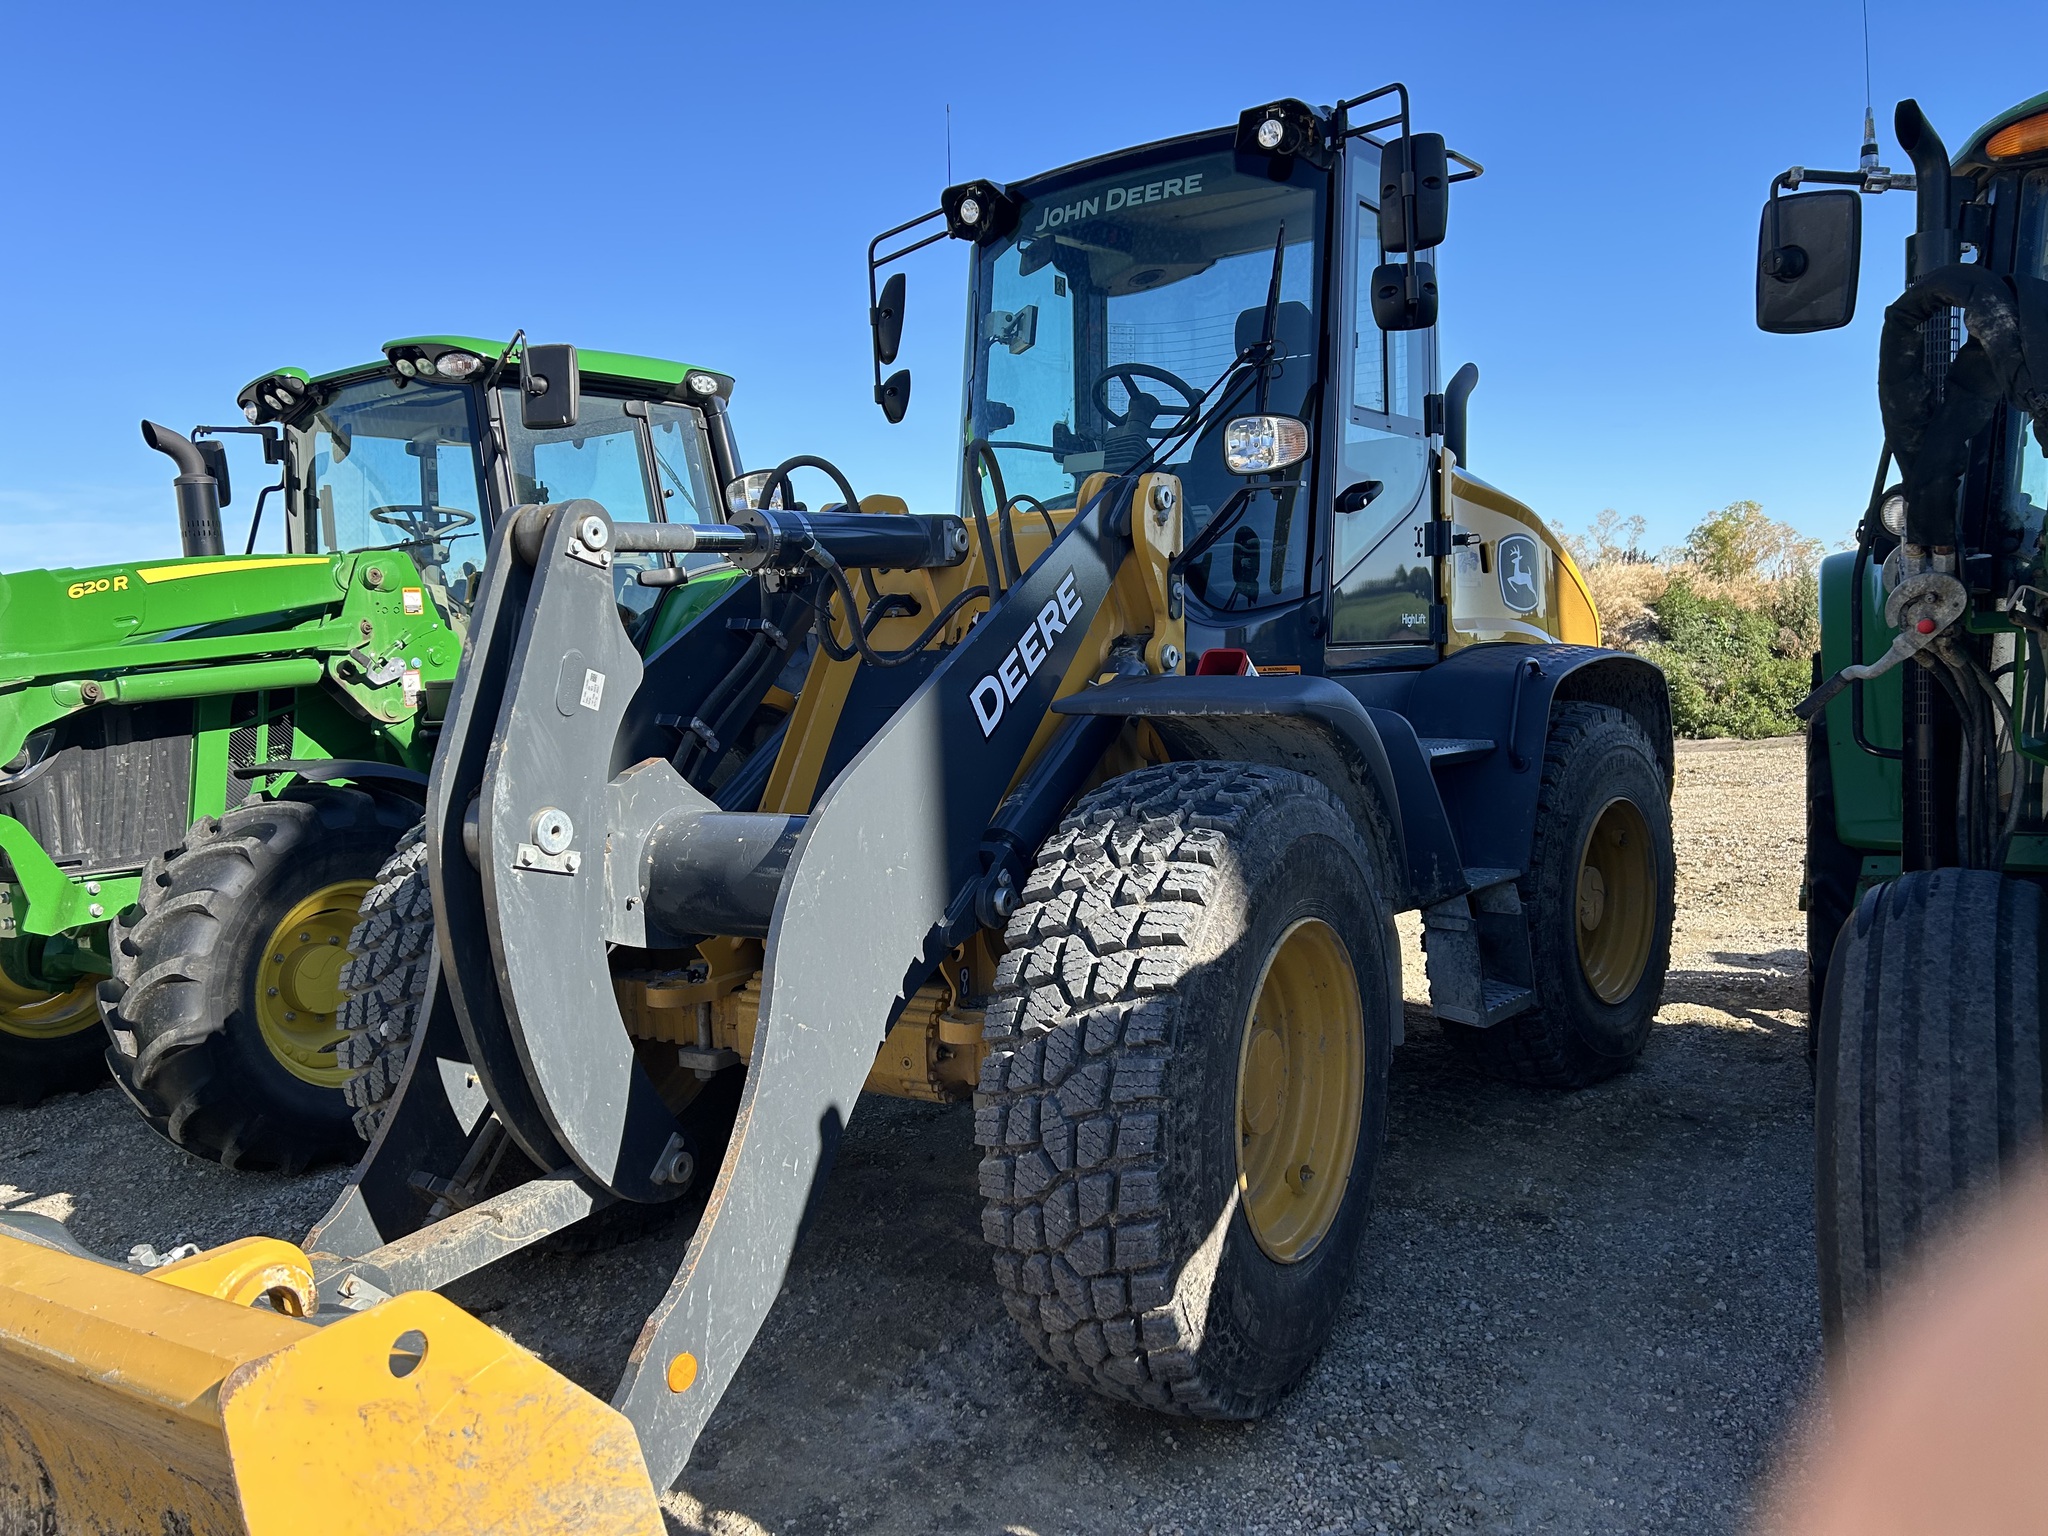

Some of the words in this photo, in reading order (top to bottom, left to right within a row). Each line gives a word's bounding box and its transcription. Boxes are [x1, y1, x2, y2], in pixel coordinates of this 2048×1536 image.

[1035, 197, 1099, 232] JOHN
[1105, 173, 1203, 212] DEERE
[67, 578, 110, 599] 620
[113, 575, 129, 592] R
[969, 571, 1083, 738] DEERE
